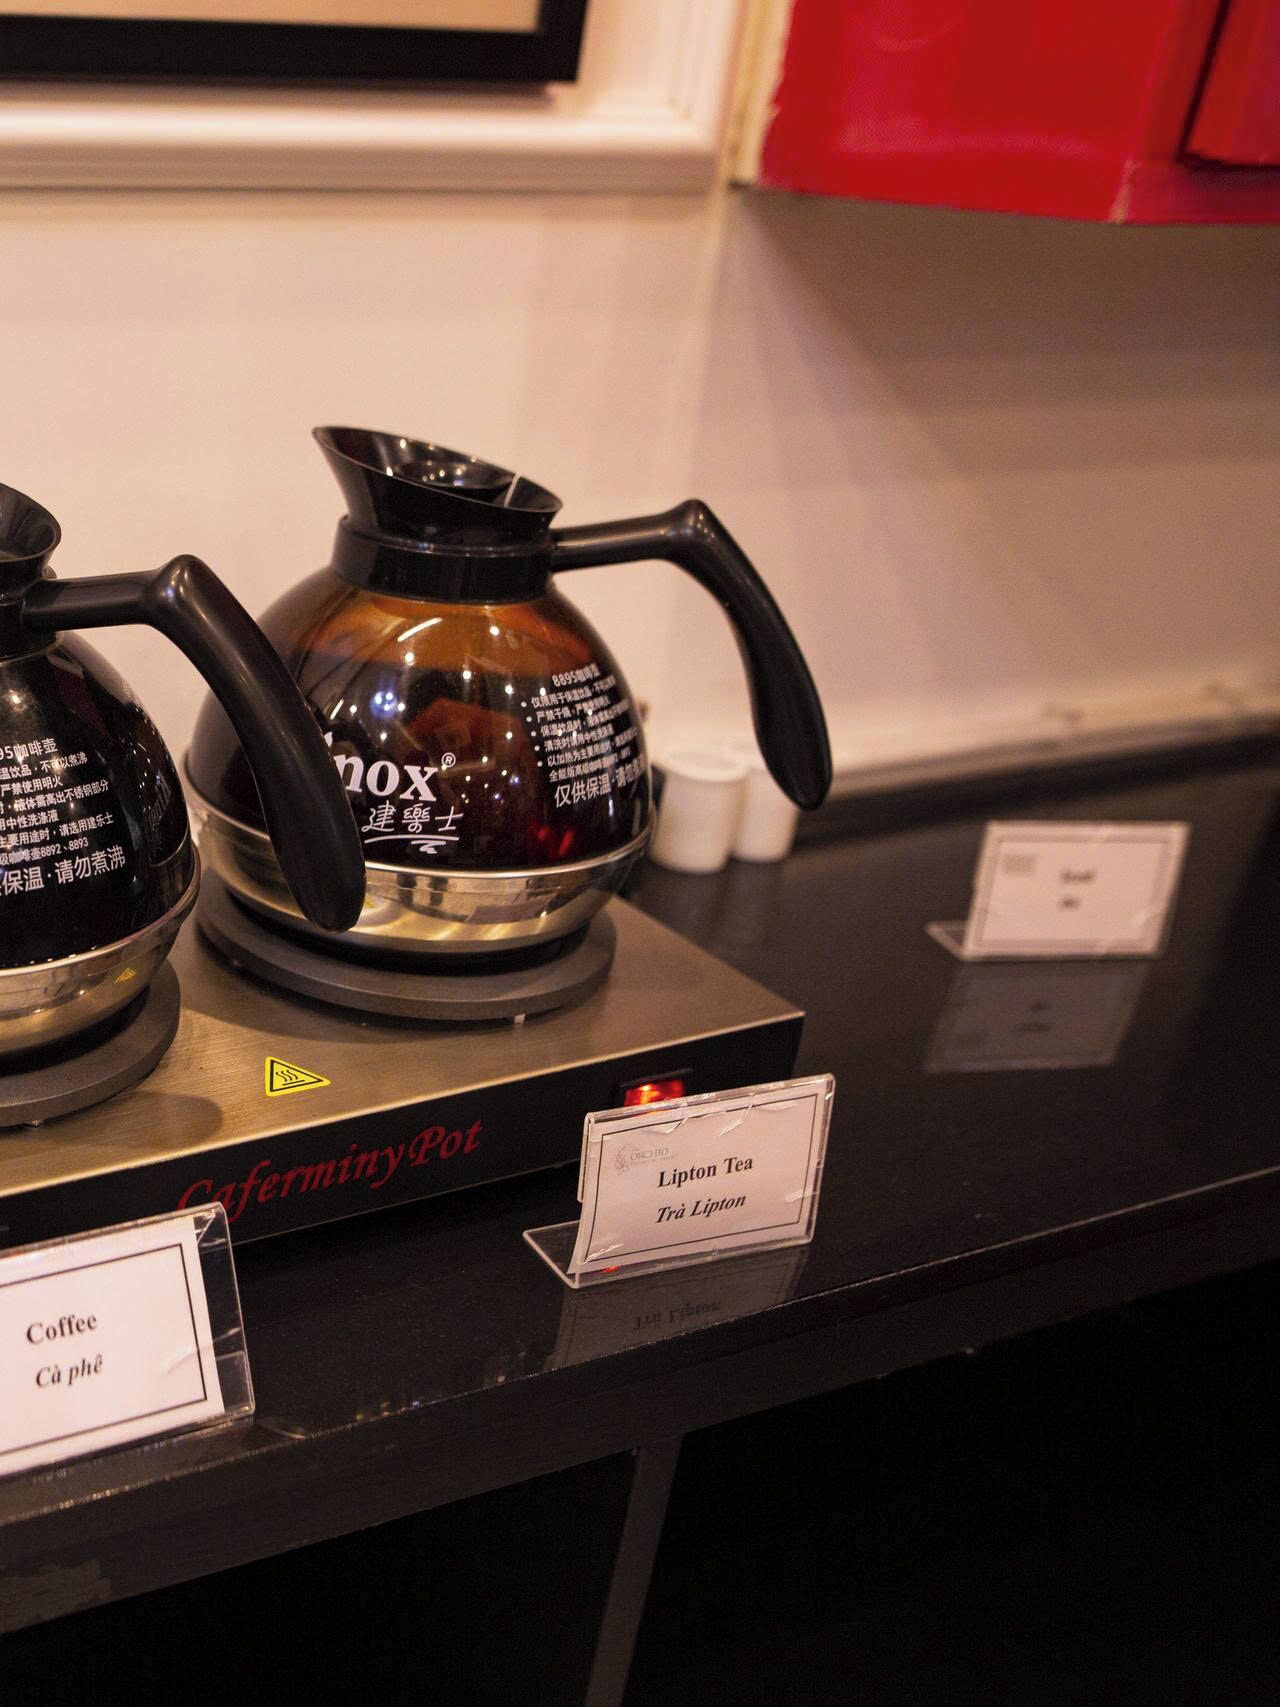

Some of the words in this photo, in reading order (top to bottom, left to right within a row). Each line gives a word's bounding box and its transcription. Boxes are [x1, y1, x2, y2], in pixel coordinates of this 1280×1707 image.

[324, 732, 438, 801] nox
[657, 1166, 717, 1188] Lipton
[724, 1156, 754, 1174] Tea
[656, 1203, 685, 1223] Trà
[690, 1195, 747, 1217] Lipton
[26, 1314, 98, 1345] Coffee
[36, 1366, 61, 1388] Cà
[70, 1354, 103, 1386] phê
